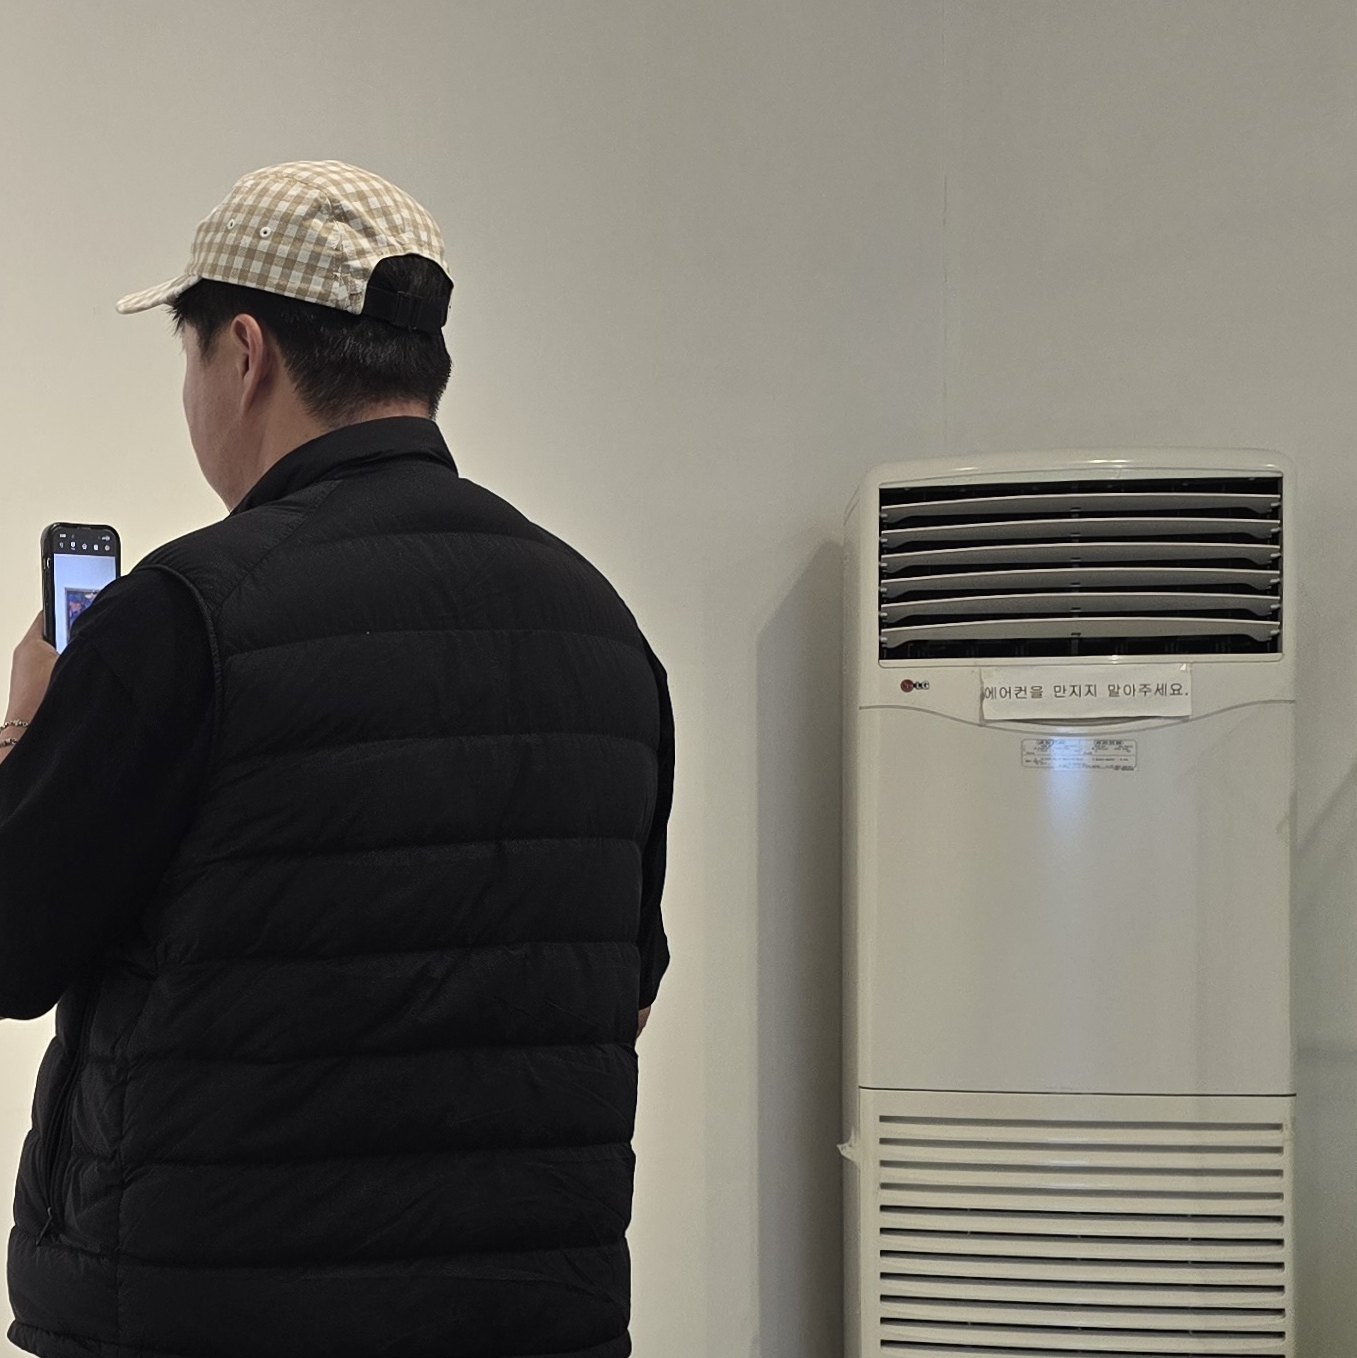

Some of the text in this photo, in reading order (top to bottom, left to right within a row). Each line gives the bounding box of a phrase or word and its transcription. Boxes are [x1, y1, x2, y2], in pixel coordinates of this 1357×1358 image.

[915, 681, 930, 690] LG
[984, 682, 1189, 699] 에어컨을 만지지 말아주세요.
